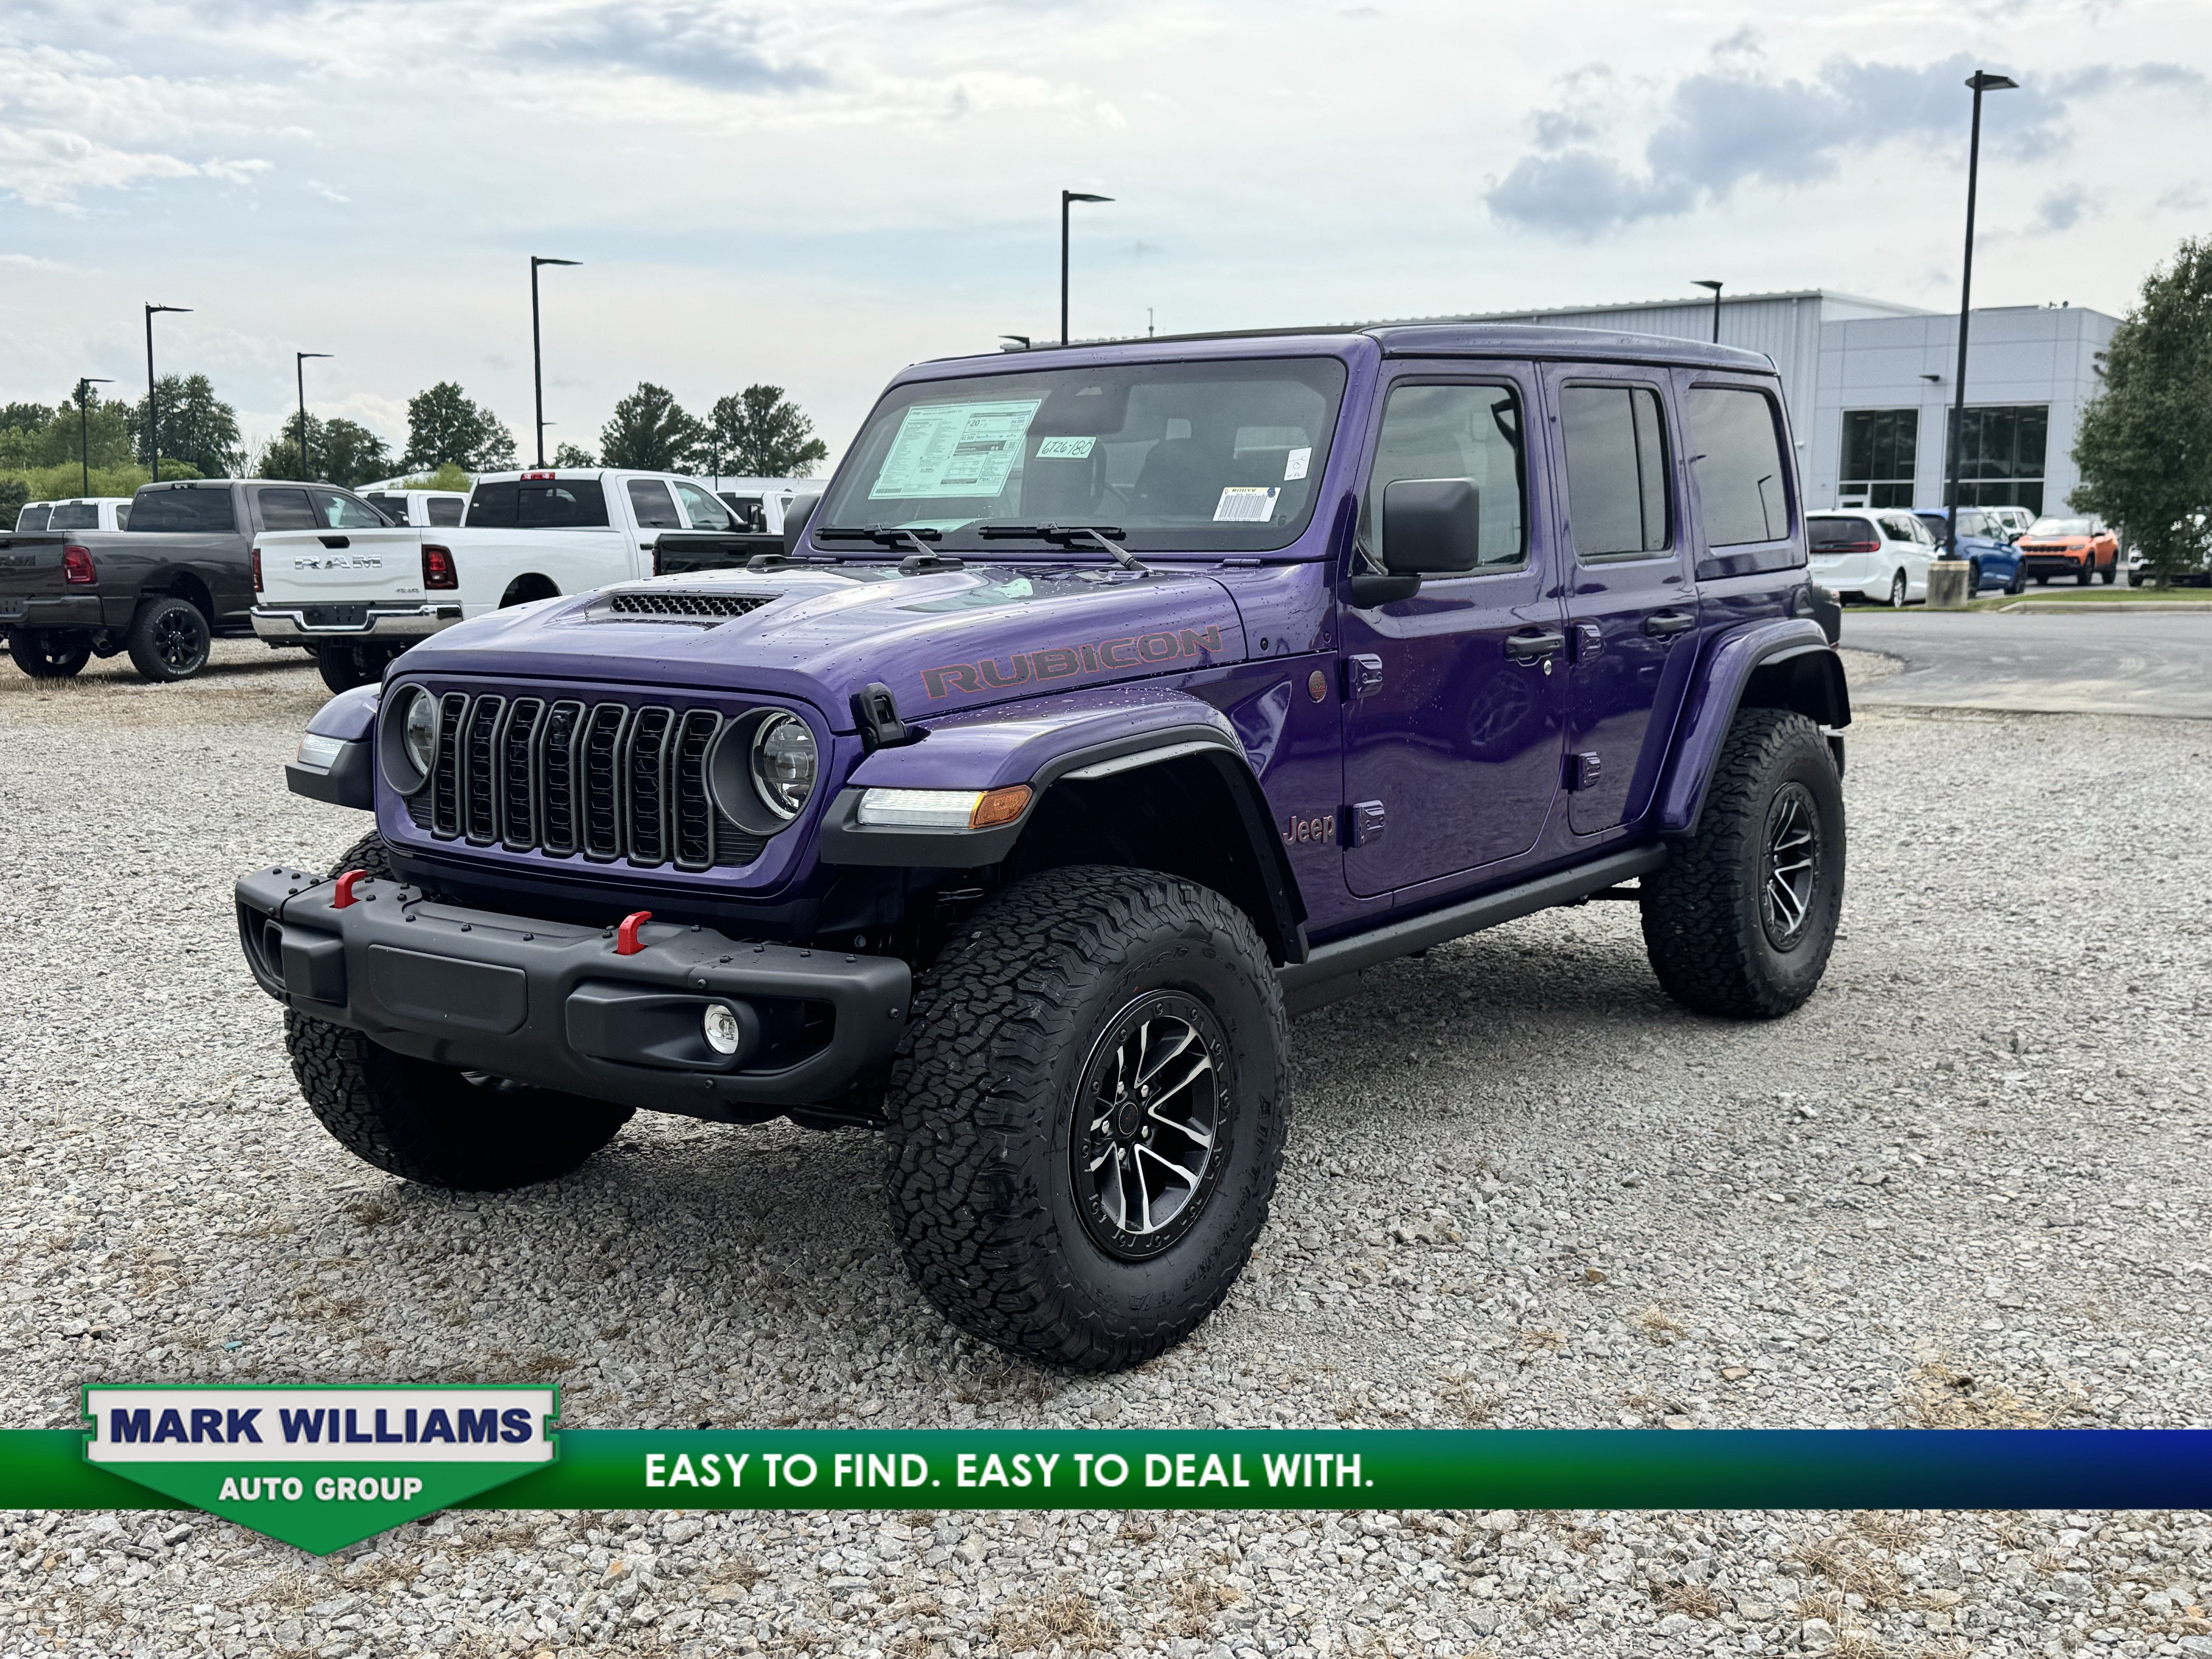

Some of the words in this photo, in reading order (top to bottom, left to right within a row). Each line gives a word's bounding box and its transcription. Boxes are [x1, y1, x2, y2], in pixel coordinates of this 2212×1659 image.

[0, 555, 36, 566] AM
[295, 555, 382, 569] RAM
[920, 625, 1224, 699] RUBICON
[1282, 815, 1336, 846] Jeep
